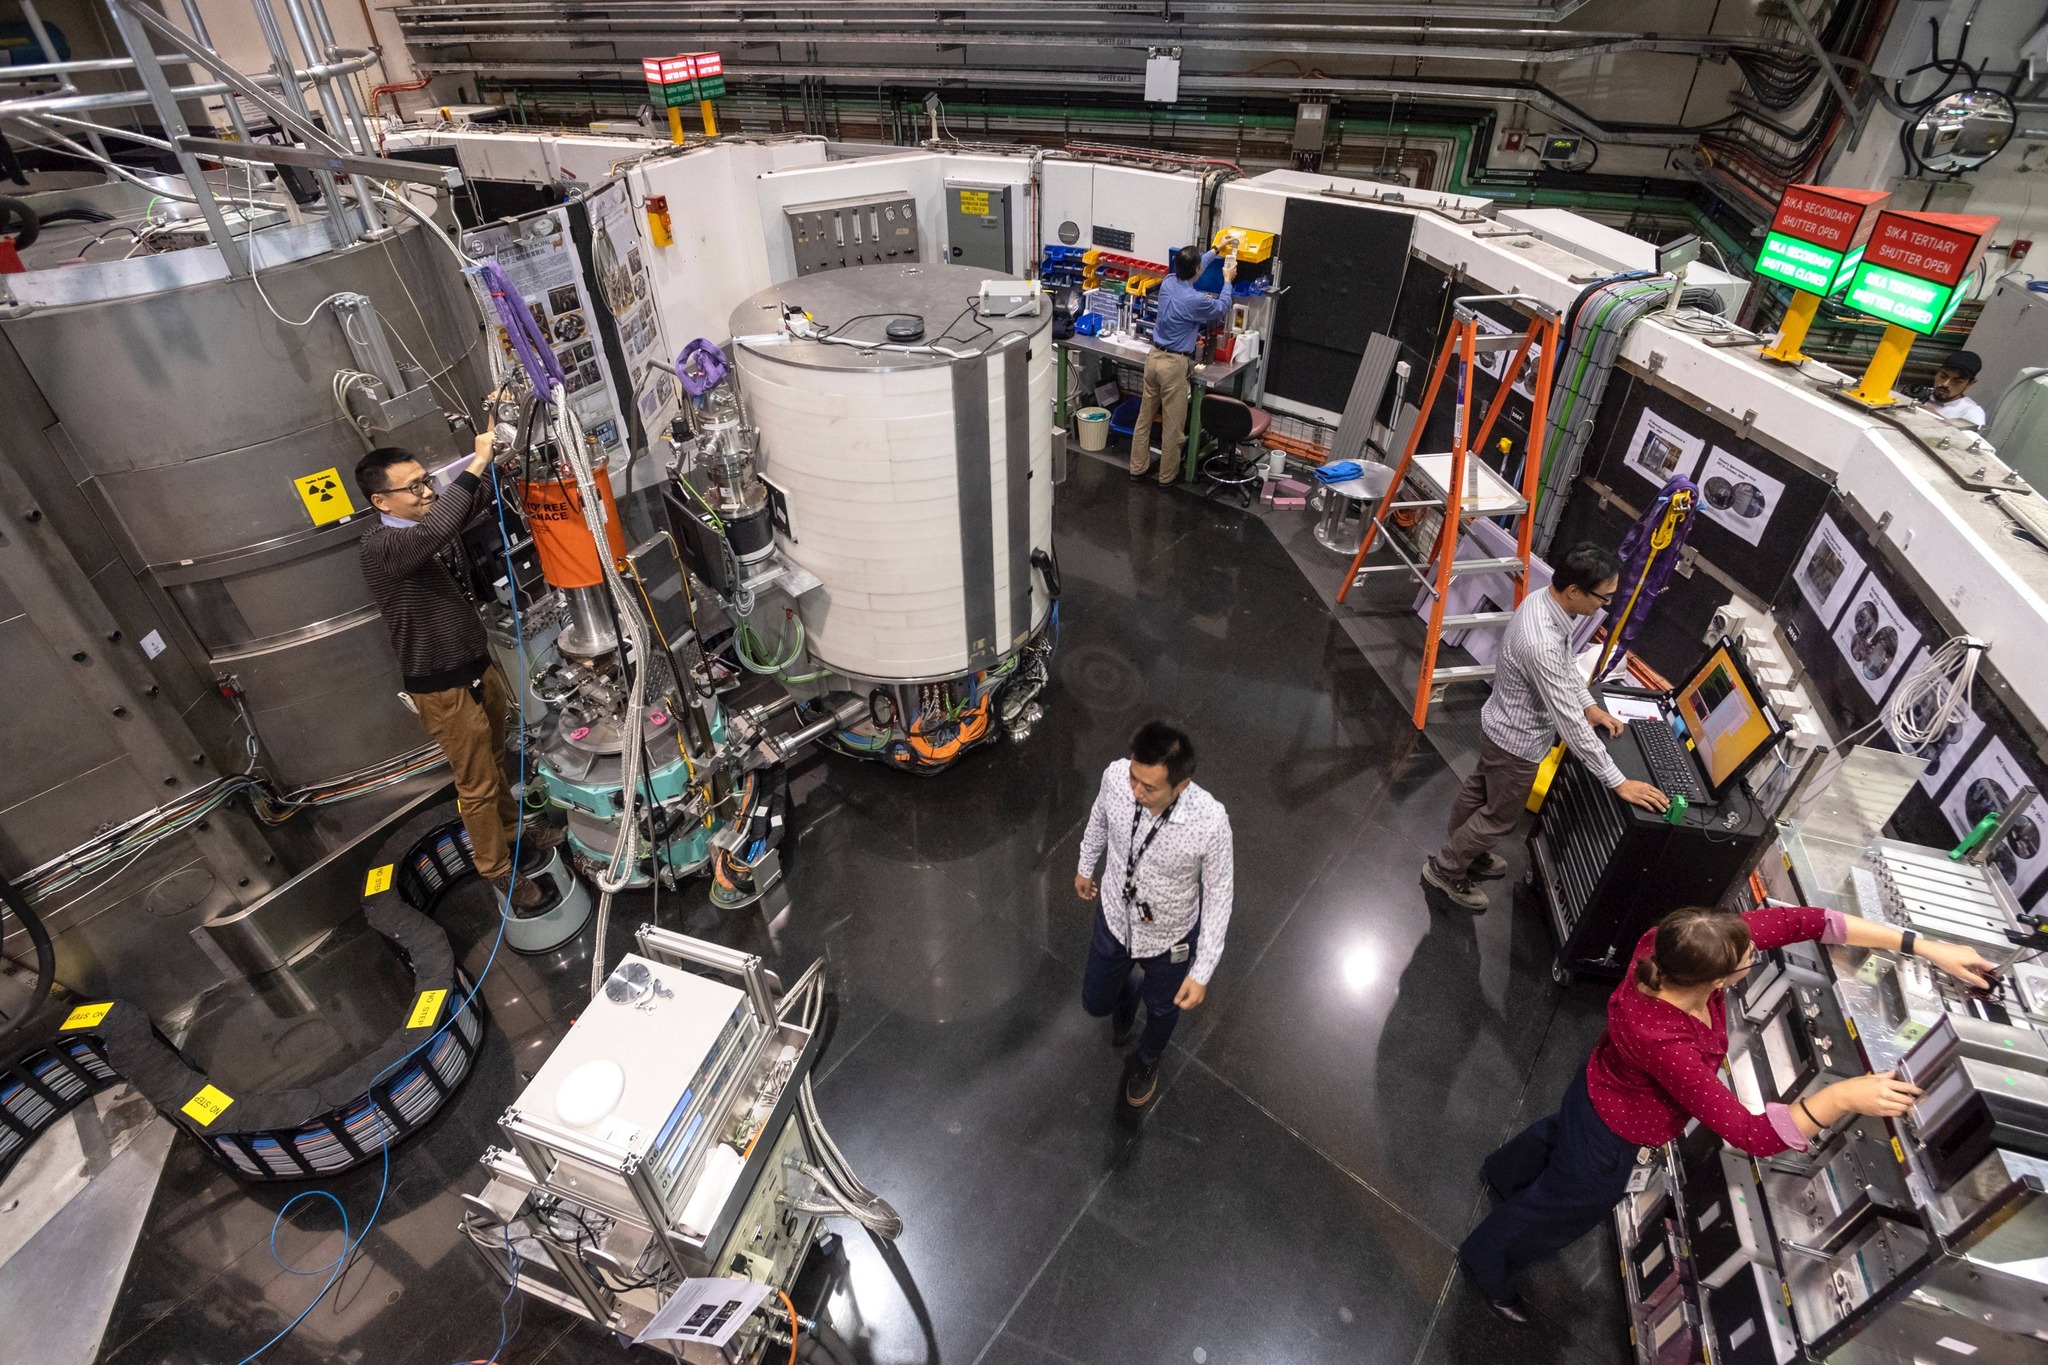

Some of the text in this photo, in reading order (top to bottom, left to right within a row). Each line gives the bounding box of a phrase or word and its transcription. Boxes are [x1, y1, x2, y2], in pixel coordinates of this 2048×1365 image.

[1783, 196, 1855, 224] SIKA SECONDARY
[1782, 215, 1840, 240] SHUTTER OPEN
[1884, 225, 1959, 255] SIKA TERTIARY
[1767, 239, 1835, 270] SIKA SECONDARY
[1879, 244, 1952, 275] SHUTTER OPEN
[1761, 256, 1828, 288] SHUTTER CLOSED
[1864, 271, 1938, 304] SIKA TERTIARY
[1852, 288, 1934, 325] SHUTTER CLOSED
[1786, 625, 1798, 642] 2010
[373, 867, 384, 893] NO STEP
[68, 1011, 105, 1021] NO STEP
[417, 991, 437, 1026] NO STEP
[193, 1095, 222, 1116] NO STEP
[648, 1150, 659, 1166] 06
